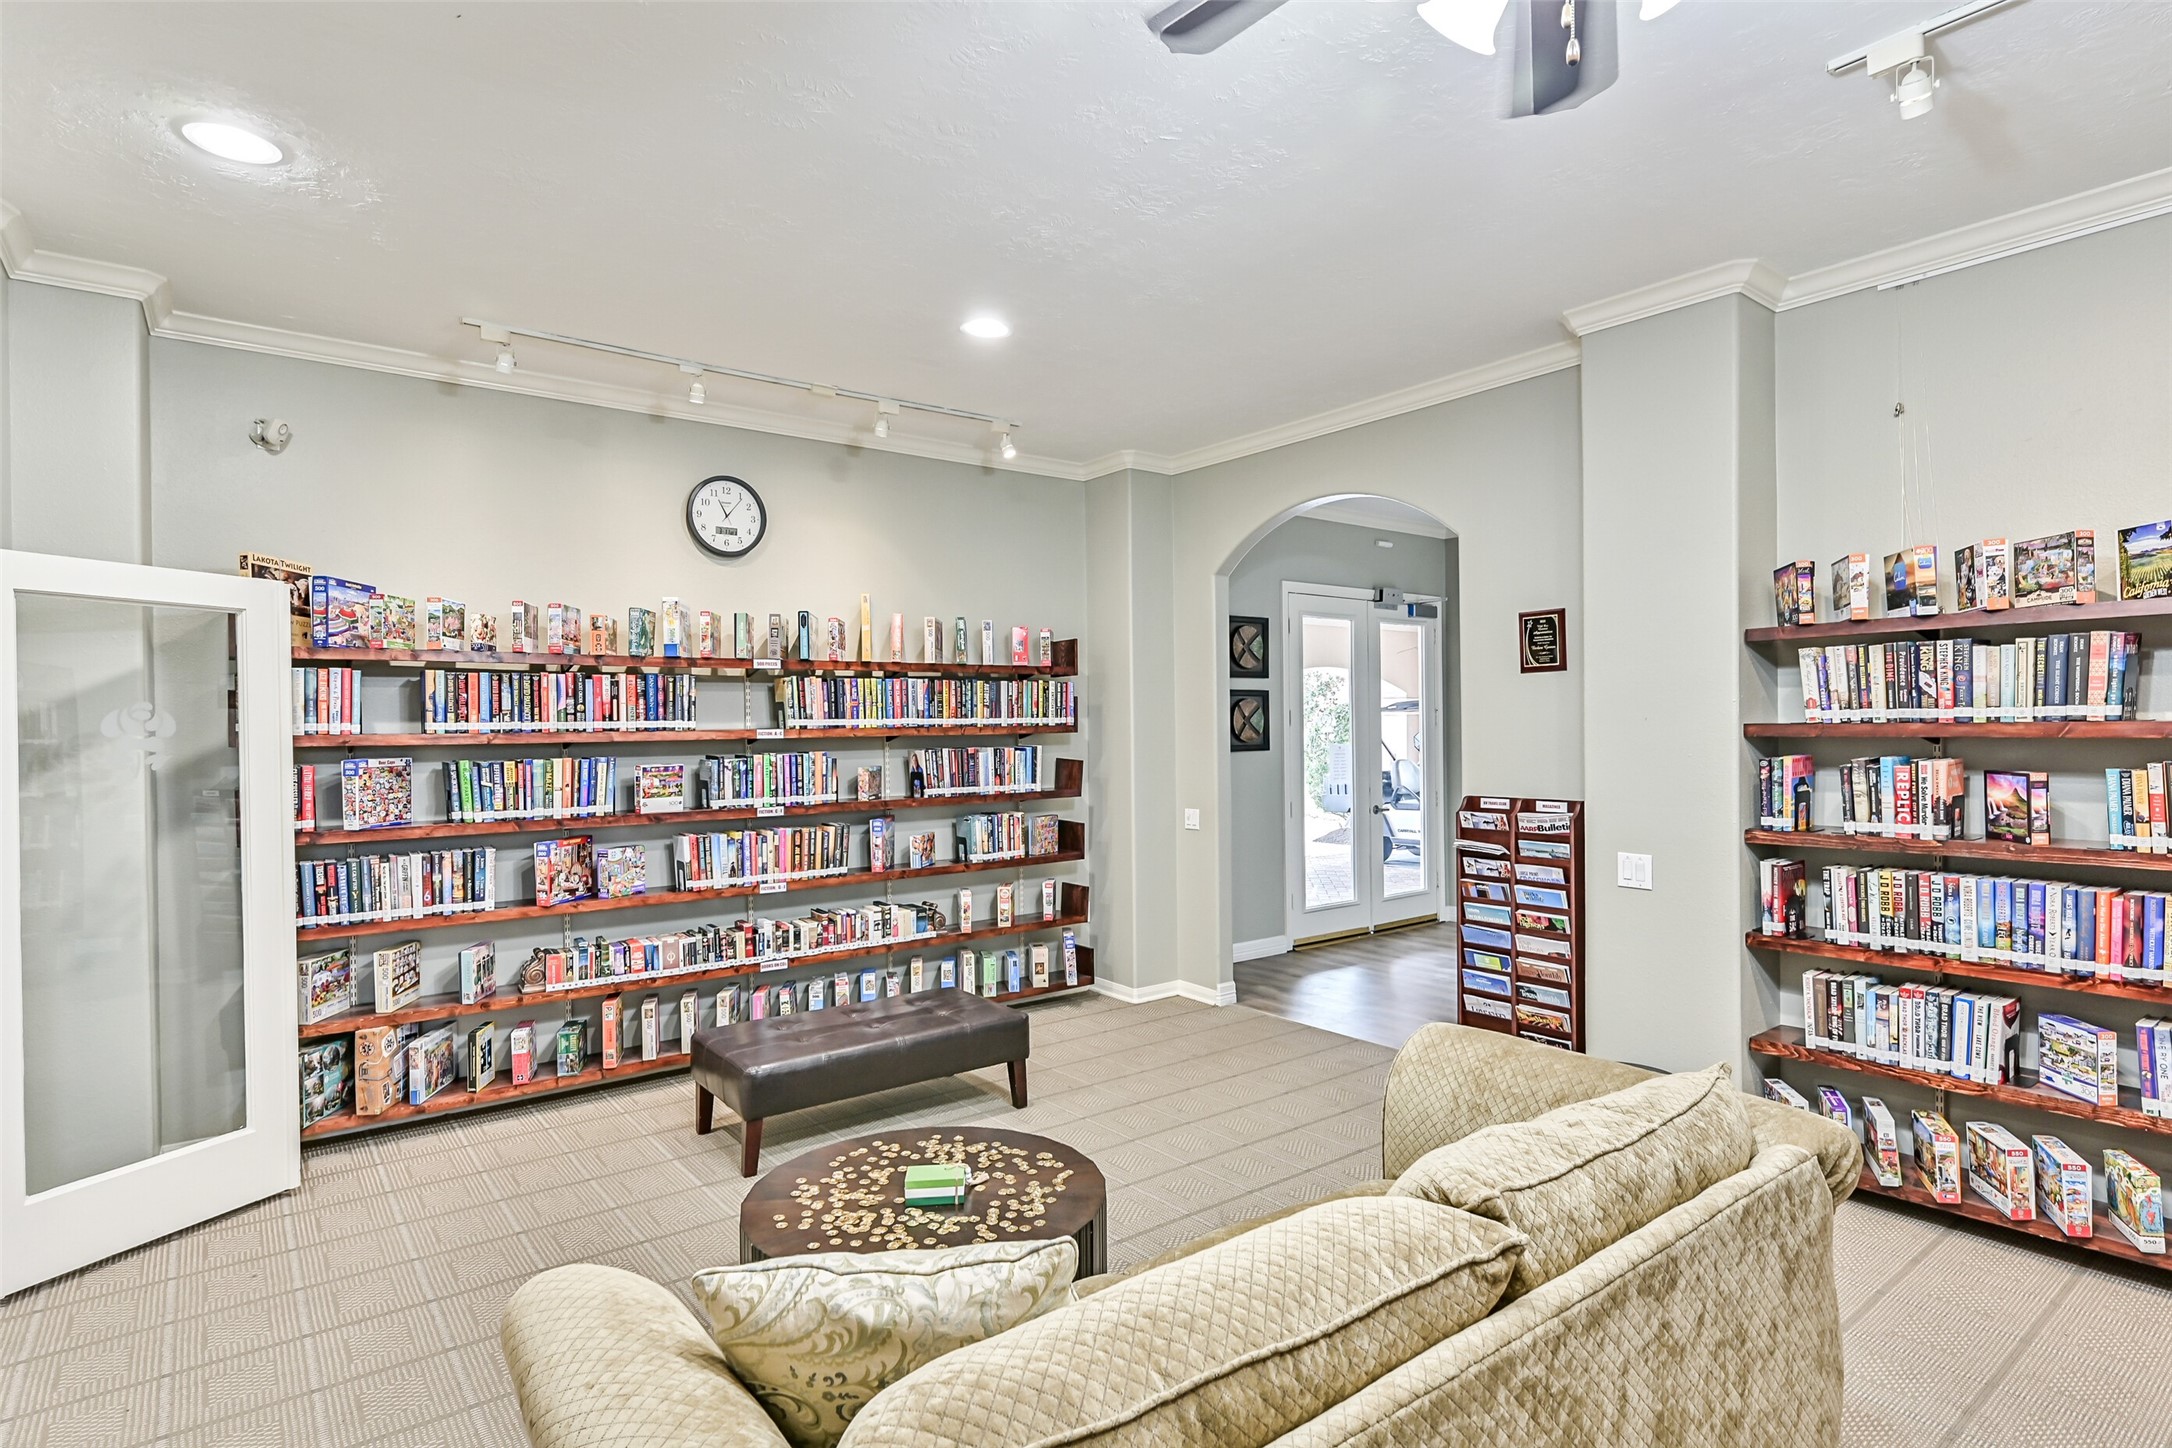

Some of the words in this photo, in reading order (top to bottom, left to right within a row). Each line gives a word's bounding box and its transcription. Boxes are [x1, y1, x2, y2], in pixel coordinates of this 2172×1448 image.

[710, 489, 718, 497] 11
[252, 554, 278, 566] LAKOTA
[280, 560, 312, 574] TWILIGHT
[2123, 579, 2170, 599] California
[1920, 647, 1930, 672] KING
[1939, 644, 1948, 670] STEPHEN
[1954, 644, 1963, 670] KING
[1886, 664, 1894, 682] DIME
[1899, 652, 1907, 686] Providence
[1940, 672, 1950, 686] KING
[2037, 654, 2045, 684] SECRETARY
[1921, 776, 1929, 786] We
[2108, 774, 2118, 792] DIANA
[2122, 778, 2131, 796] DIANA
[1897, 772, 1910, 824] REPLIC
[1920, 786, 1929, 802] Solve
[2109, 793, 2119, 812] PALMER
[1921, 803, 1929, 825] Murder
[2123, 796, 2132, 816] PALMER
[1823, 881, 1831, 896] TRAP
[1881, 890, 1890, 912] ROBB
[1894, 892, 1904, 912] ROBB
[1920, 896, 1930, 918] ROBB
[1932, 896, 1942, 918] ROBB
[2049, 892, 2058, 908] NORA
[2048, 909, 2058, 930] ROBERTS
[1992, 1008, 2000, 1026] Blood
[1990, 1028, 2000, 1052] Orange
[2160, 1066, 2168, 1080] ONE
[2080, 1084, 2096, 1098] 300
